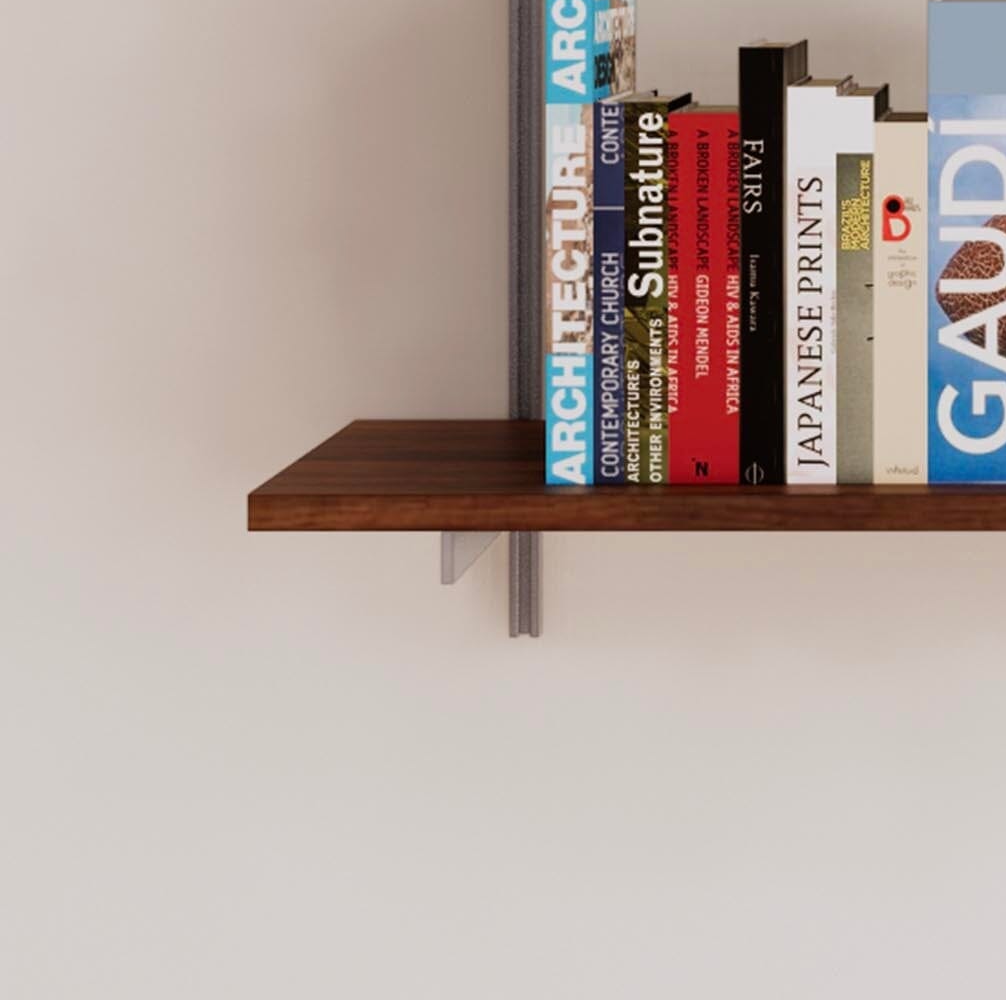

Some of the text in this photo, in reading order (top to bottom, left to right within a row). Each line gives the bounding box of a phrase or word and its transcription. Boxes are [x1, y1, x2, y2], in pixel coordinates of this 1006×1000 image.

[695, 142, 710, 193] BROKEN
[725, 142, 740, 193] BROKEN
[743, 139, 764, 214] FAIRS
[860, 159, 871, 250] ARCHITECTURE
[627, 111, 664, 299] Subnature
[695, 197, 710, 271] LANDSCAPE
[725, 197, 740, 271] LANDSCAPE
[552, 124, 588, 485] ARCHITECTURE
[695, 274, 710, 324] GIDEON
[725, 274, 740, 298] HIV
[797, 176, 830, 468] JAPANESE PRINTS
[600, 252, 621, 478] CONTEMPORARY CHURCH
[695, 327, 710, 379] MENDEL
[725, 314, 740, 346] AIDS
[725, 349, 740, 364] IN
[627, 359, 641, 483] ARCHITECTURE'S
[649, 317, 663, 483] OTHER ENVIRONMENTS
[725, 367, 740, 415] AFRICA
